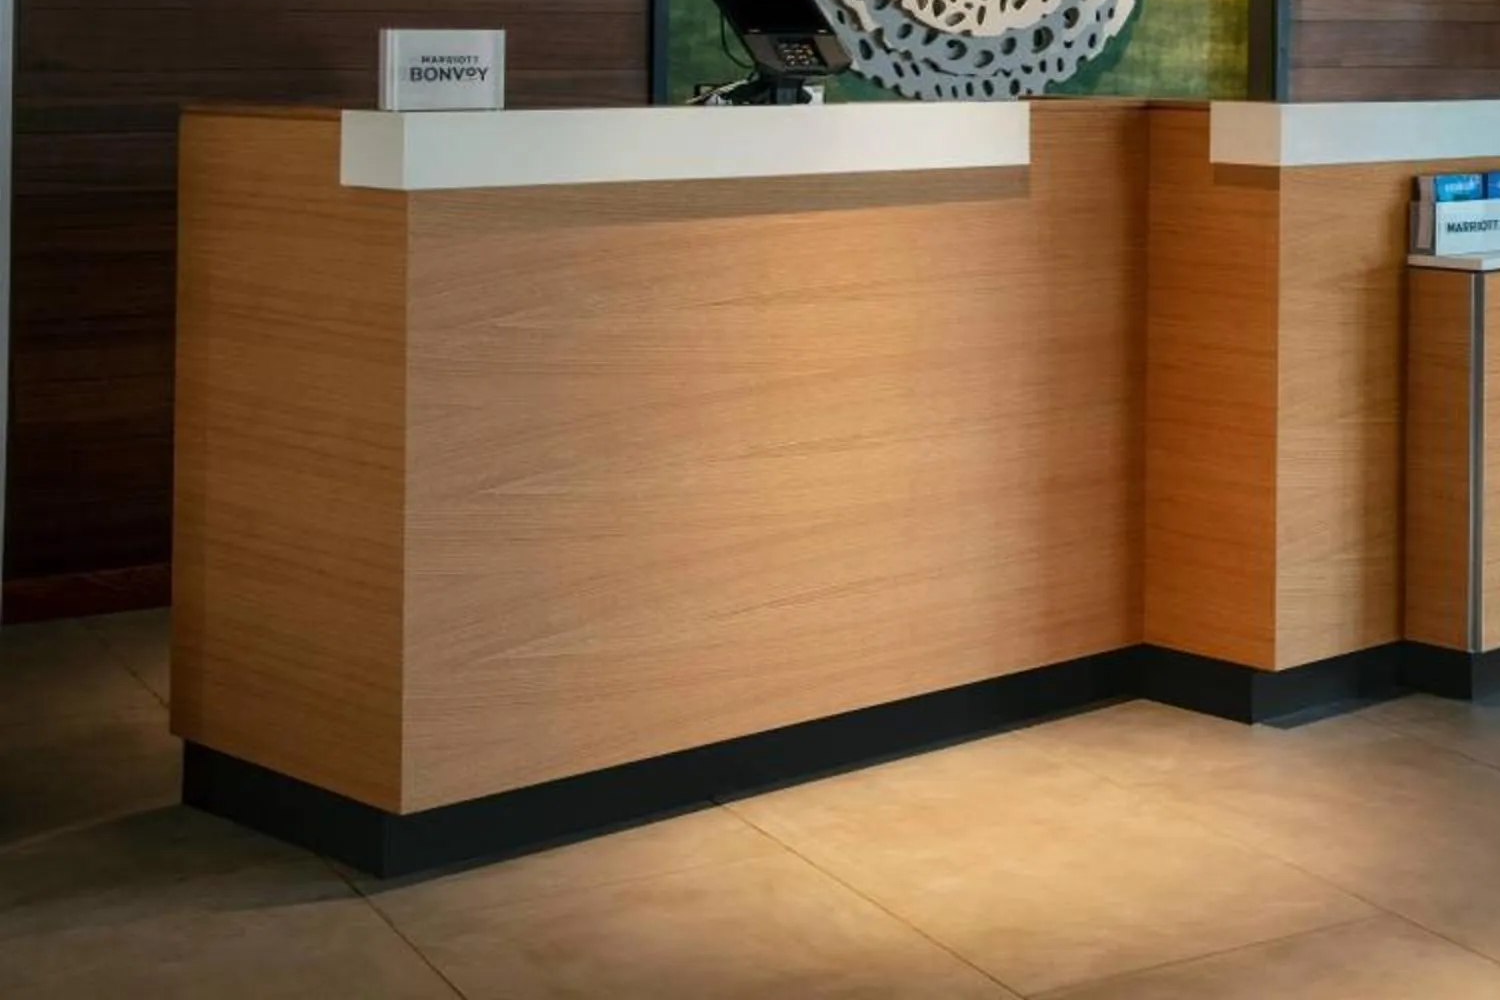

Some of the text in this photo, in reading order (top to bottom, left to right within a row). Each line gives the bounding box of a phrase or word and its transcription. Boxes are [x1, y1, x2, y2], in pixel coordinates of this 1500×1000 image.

[421, 55, 479, 64] MARRIOTT
[410, 66, 488, 81] BONVOY
[1447, 219, 1499, 233] MARRIOTT
